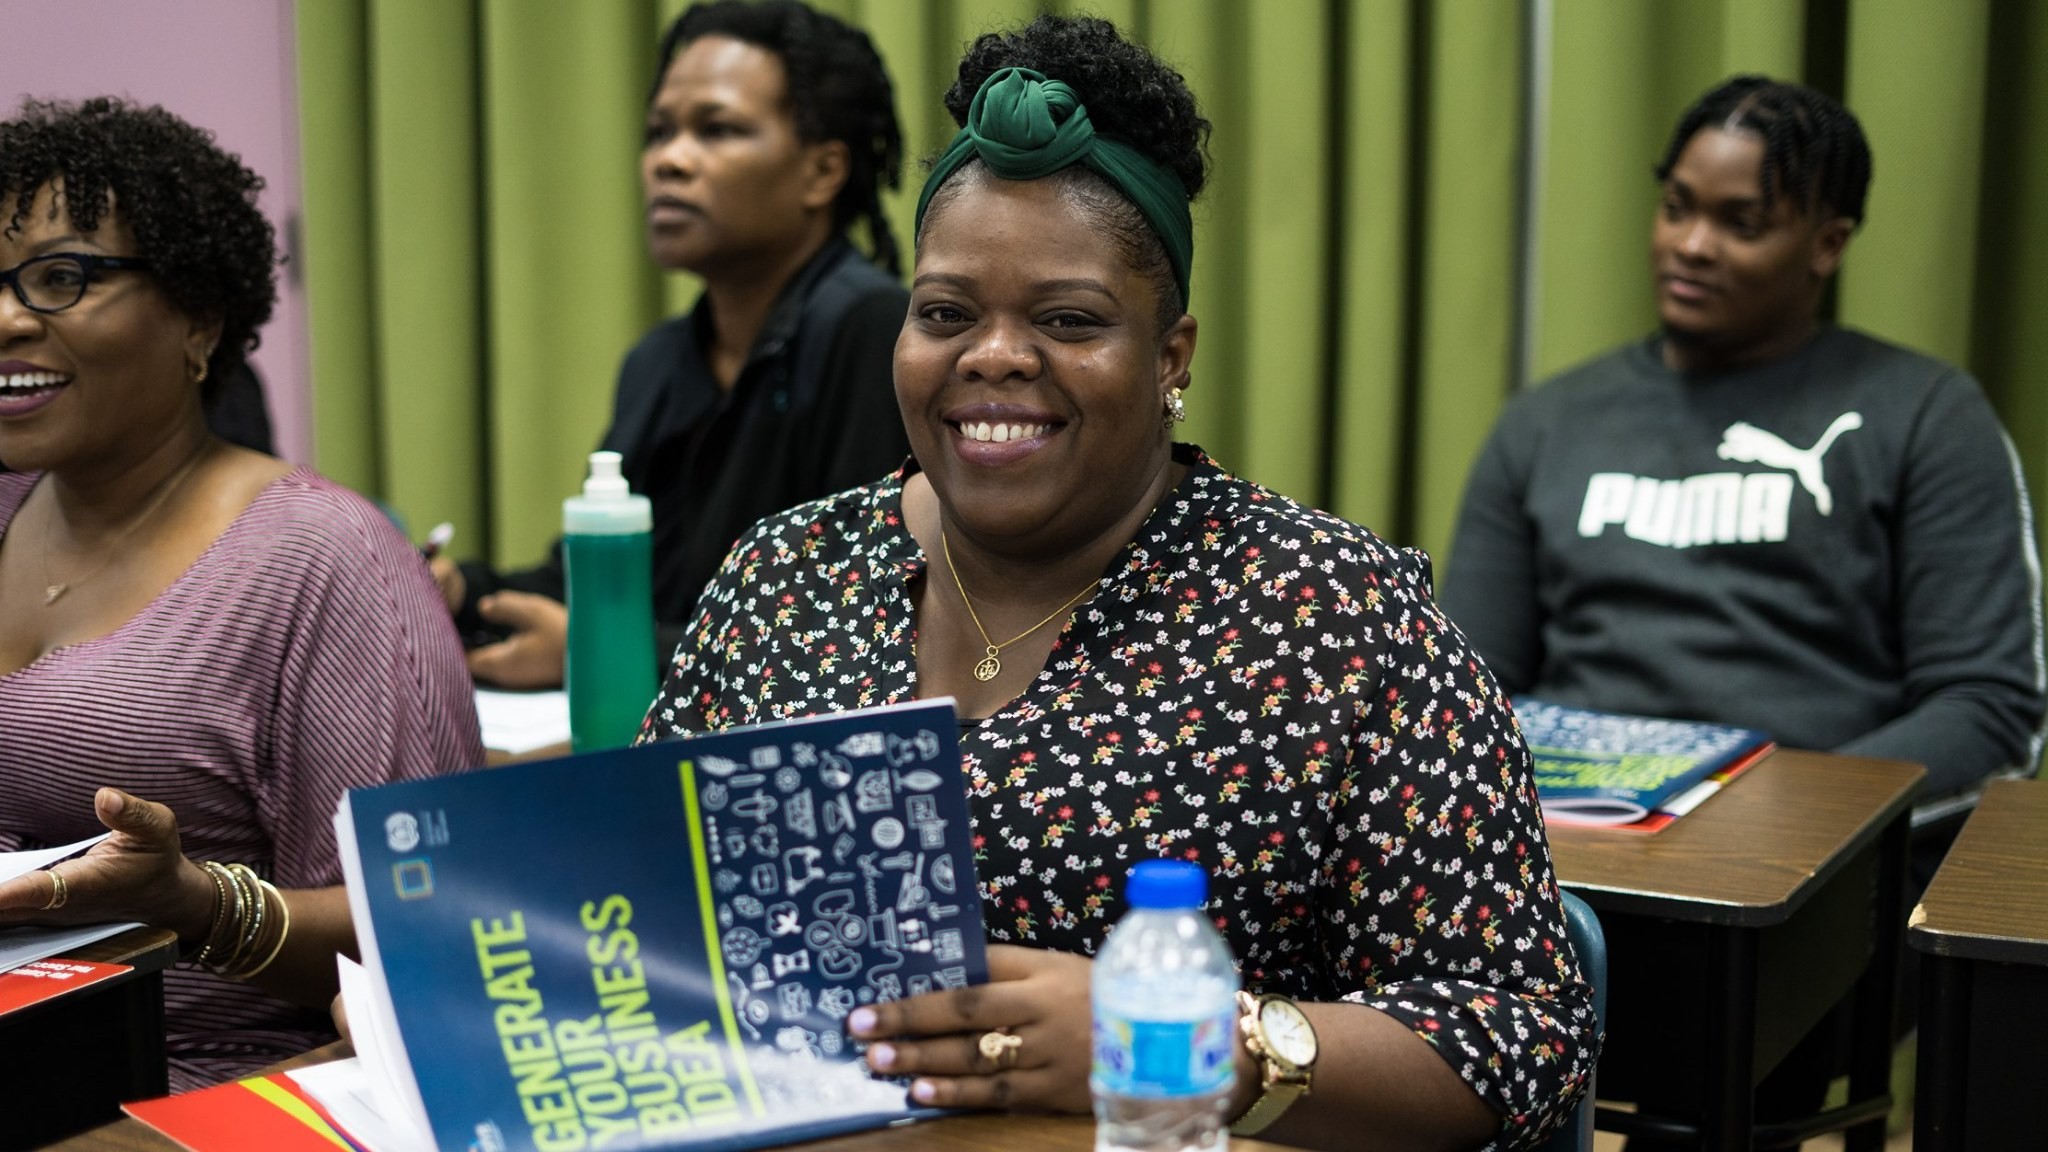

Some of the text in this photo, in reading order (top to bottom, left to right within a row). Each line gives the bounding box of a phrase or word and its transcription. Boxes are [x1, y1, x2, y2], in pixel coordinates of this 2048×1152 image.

[1577, 472, 1794, 549] PUMA
[470, 910, 587, 1152] GENERATE
[554, 1013, 638, 1149] YOUR
[579, 894, 692, 1141] BUSINESS
[664, 1019, 743, 1130] IDEA
